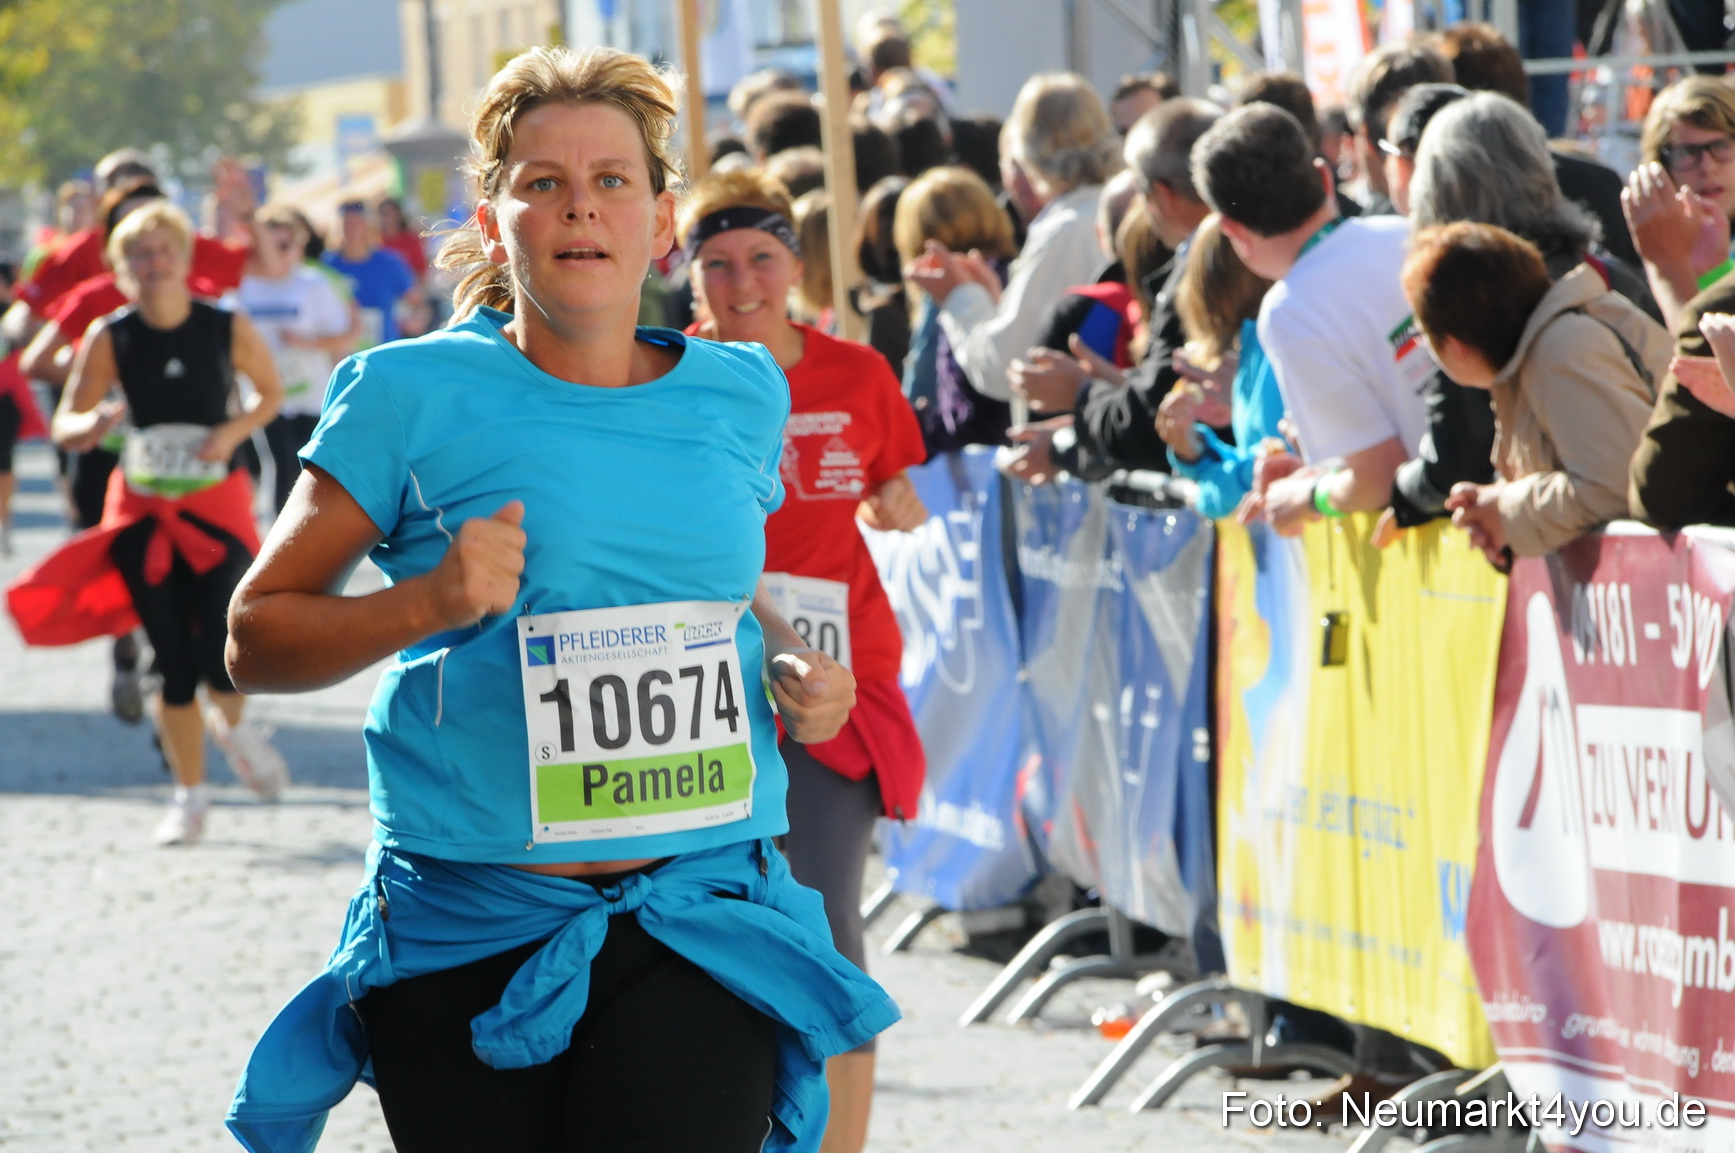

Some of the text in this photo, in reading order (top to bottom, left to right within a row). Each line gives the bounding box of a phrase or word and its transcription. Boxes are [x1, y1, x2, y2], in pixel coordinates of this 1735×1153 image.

[559, 624, 667, 652] PFLEIDERER
[560, 646, 668, 665] AKTIENGESELLSCHAFT
[540, 659, 739, 753] 10674
[582, 753, 725, 807] Pamela
